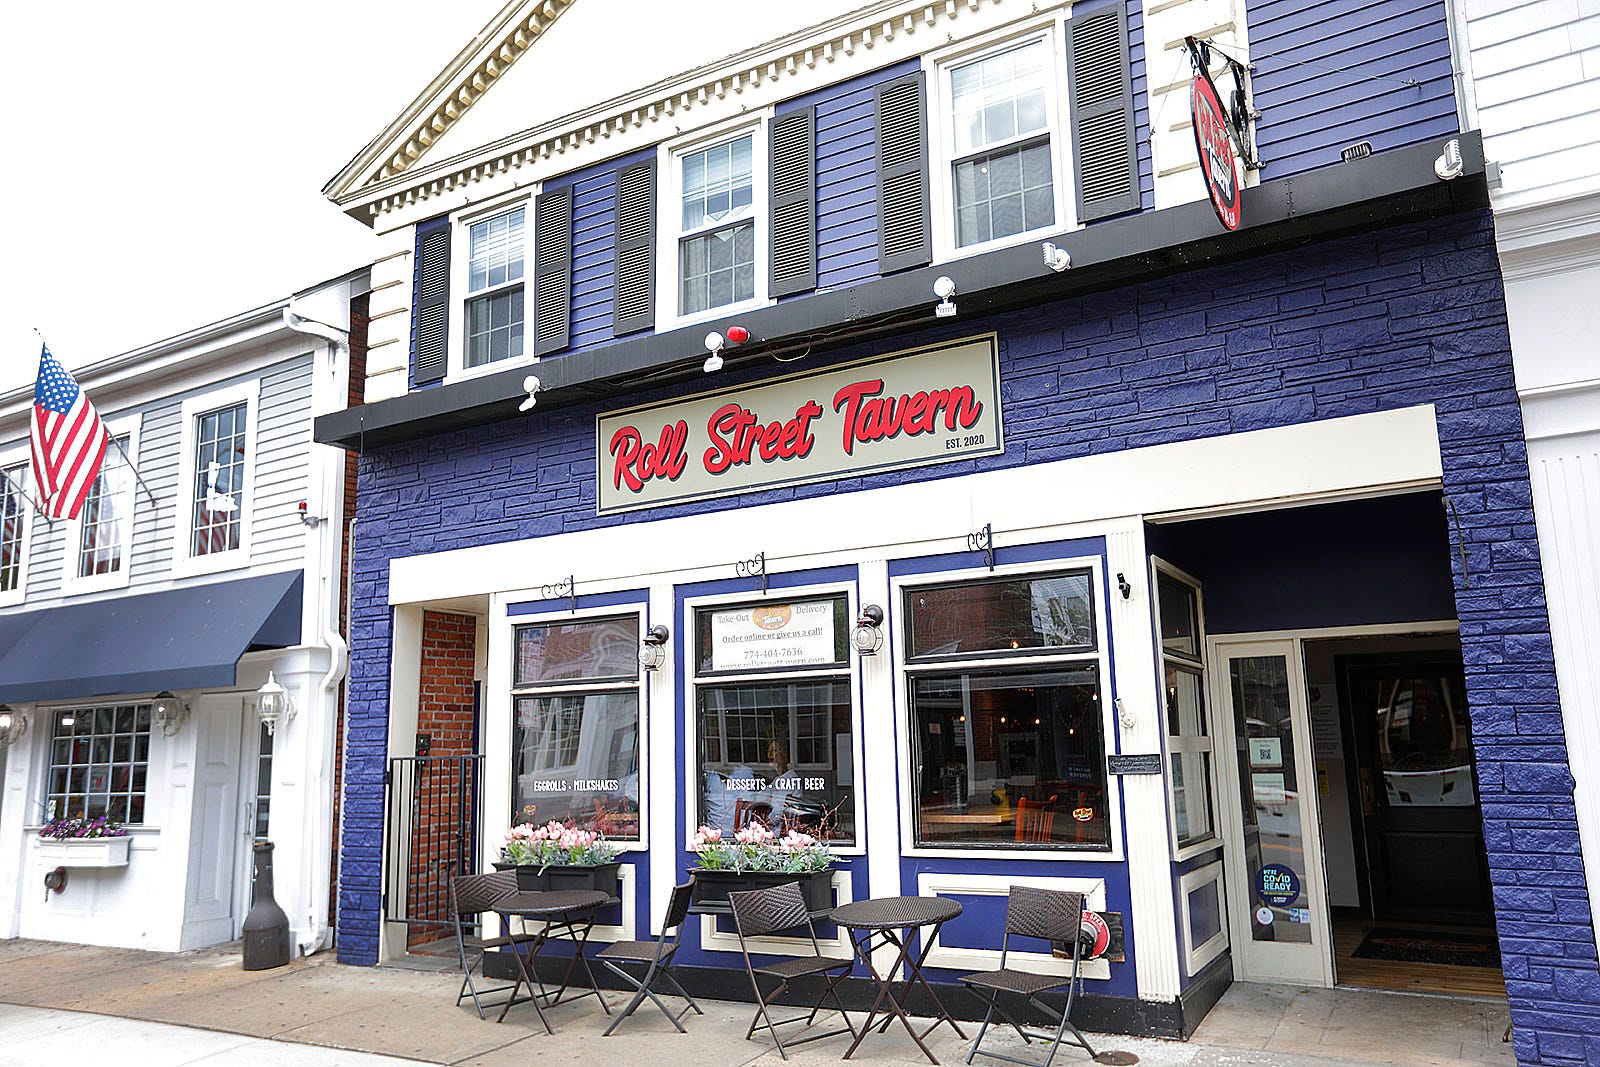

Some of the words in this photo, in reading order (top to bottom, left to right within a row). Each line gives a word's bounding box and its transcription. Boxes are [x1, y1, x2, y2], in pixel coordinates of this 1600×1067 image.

[609, 419, 689, 495] Roll
[703, 400, 823, 475] Street
[832, 378, 983, 456] Tavern
[945, 437, 962, 450] EST.
[963, 434, 985, 447] 2020
[796, 604, 828, 615] Delivery
[722, 635, 744, 644] Order
[744, 633, 767, 642] online
[767, 633, 777, 641] or
[777, 630, 791, 640] give
[792, 630, 801, 638] us
[743, 647, 803, 660] 774-404-7636
[533, 779, 567, 792] EGGROLLS
[573, 779, 619, 792] MILKSHAKES
[726, 777, 767, 791] DESSERTS
[774, 777, 802, 791] CRAFT
[804, 777, 825, 790] BEER
[1263, 873, 1291, 883] COVID
[1263, 882, 1291, 891] READY
